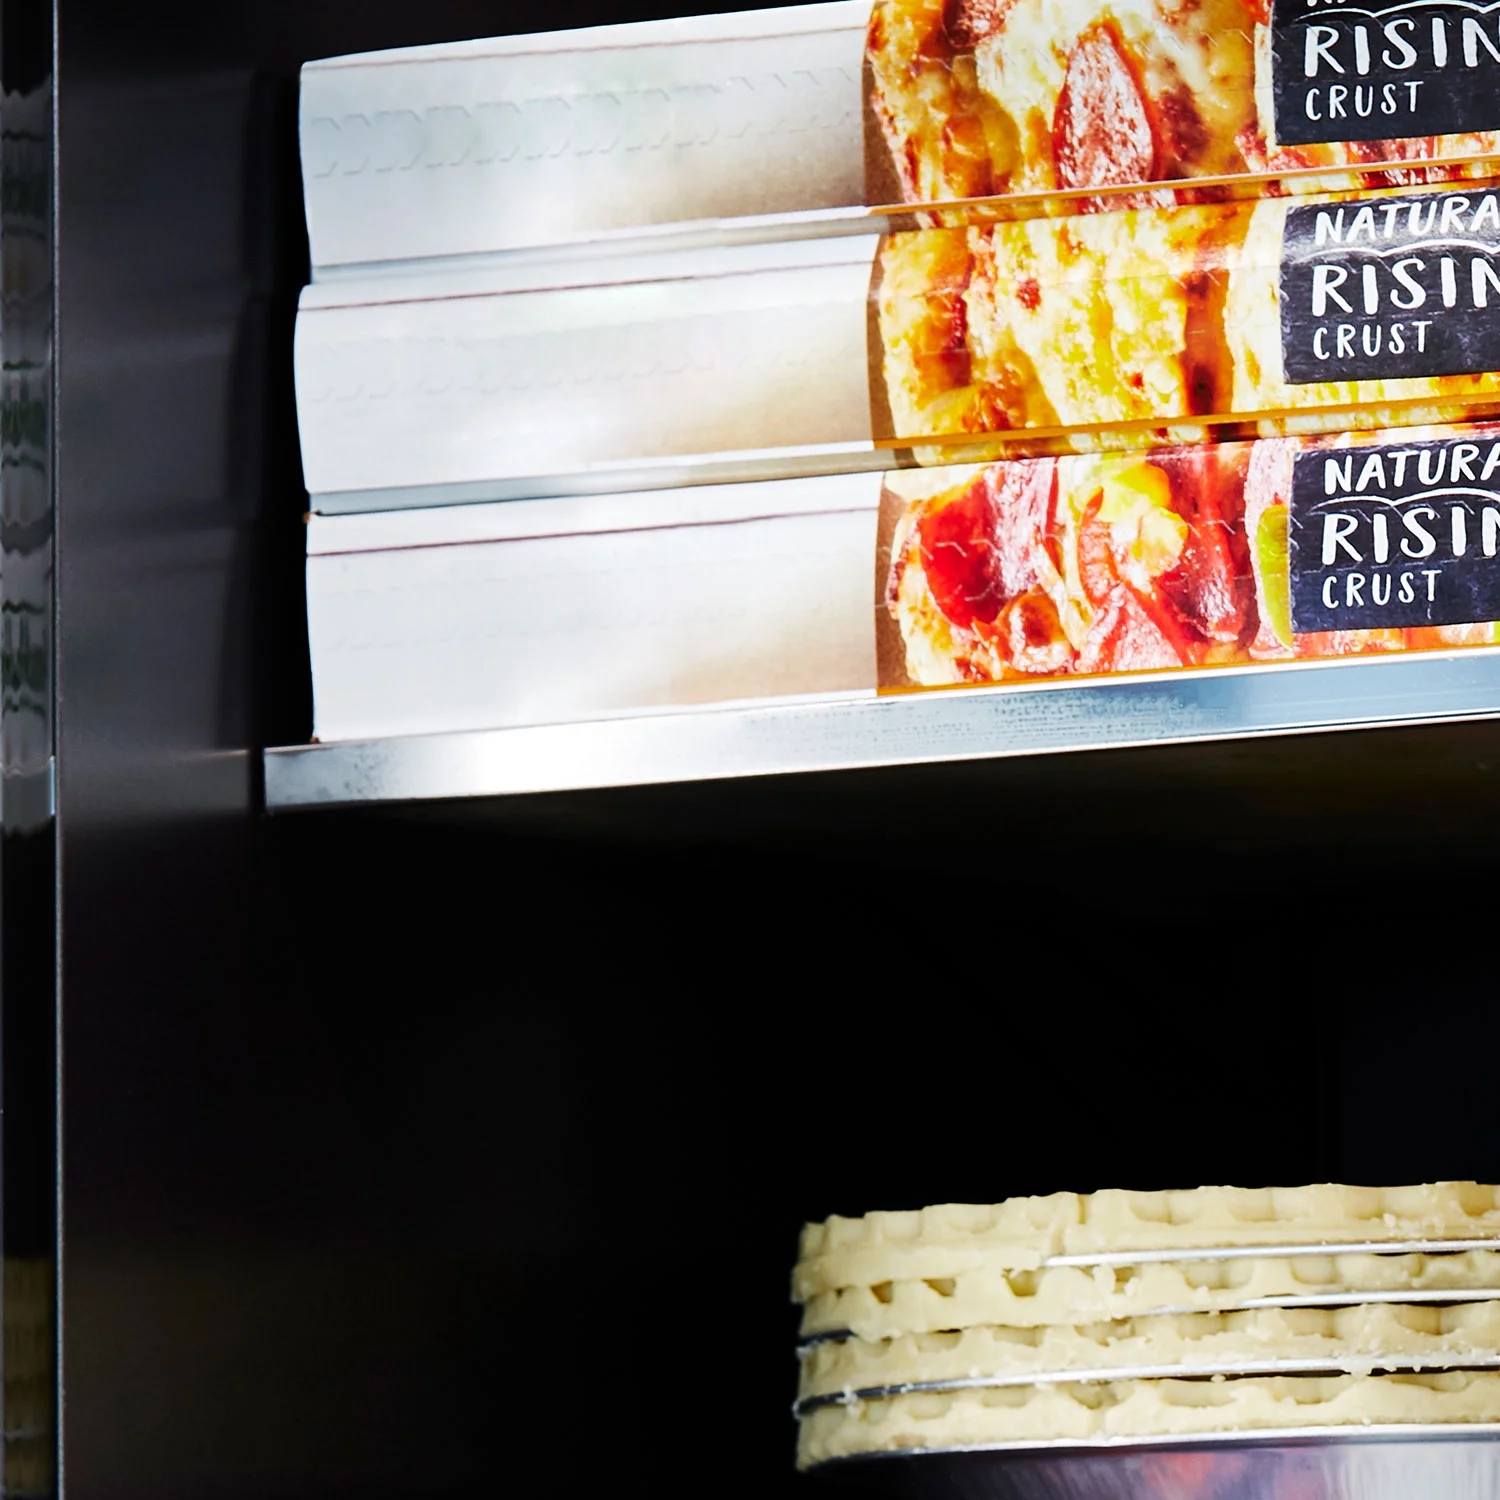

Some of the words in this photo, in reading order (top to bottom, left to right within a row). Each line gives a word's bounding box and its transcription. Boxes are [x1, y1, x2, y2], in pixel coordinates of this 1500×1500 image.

[1305, 80, 1424, 121] CRUST
[1313, 320, 1432, 360] CRUST
[1322, 569, 1442, 608] CRUST
